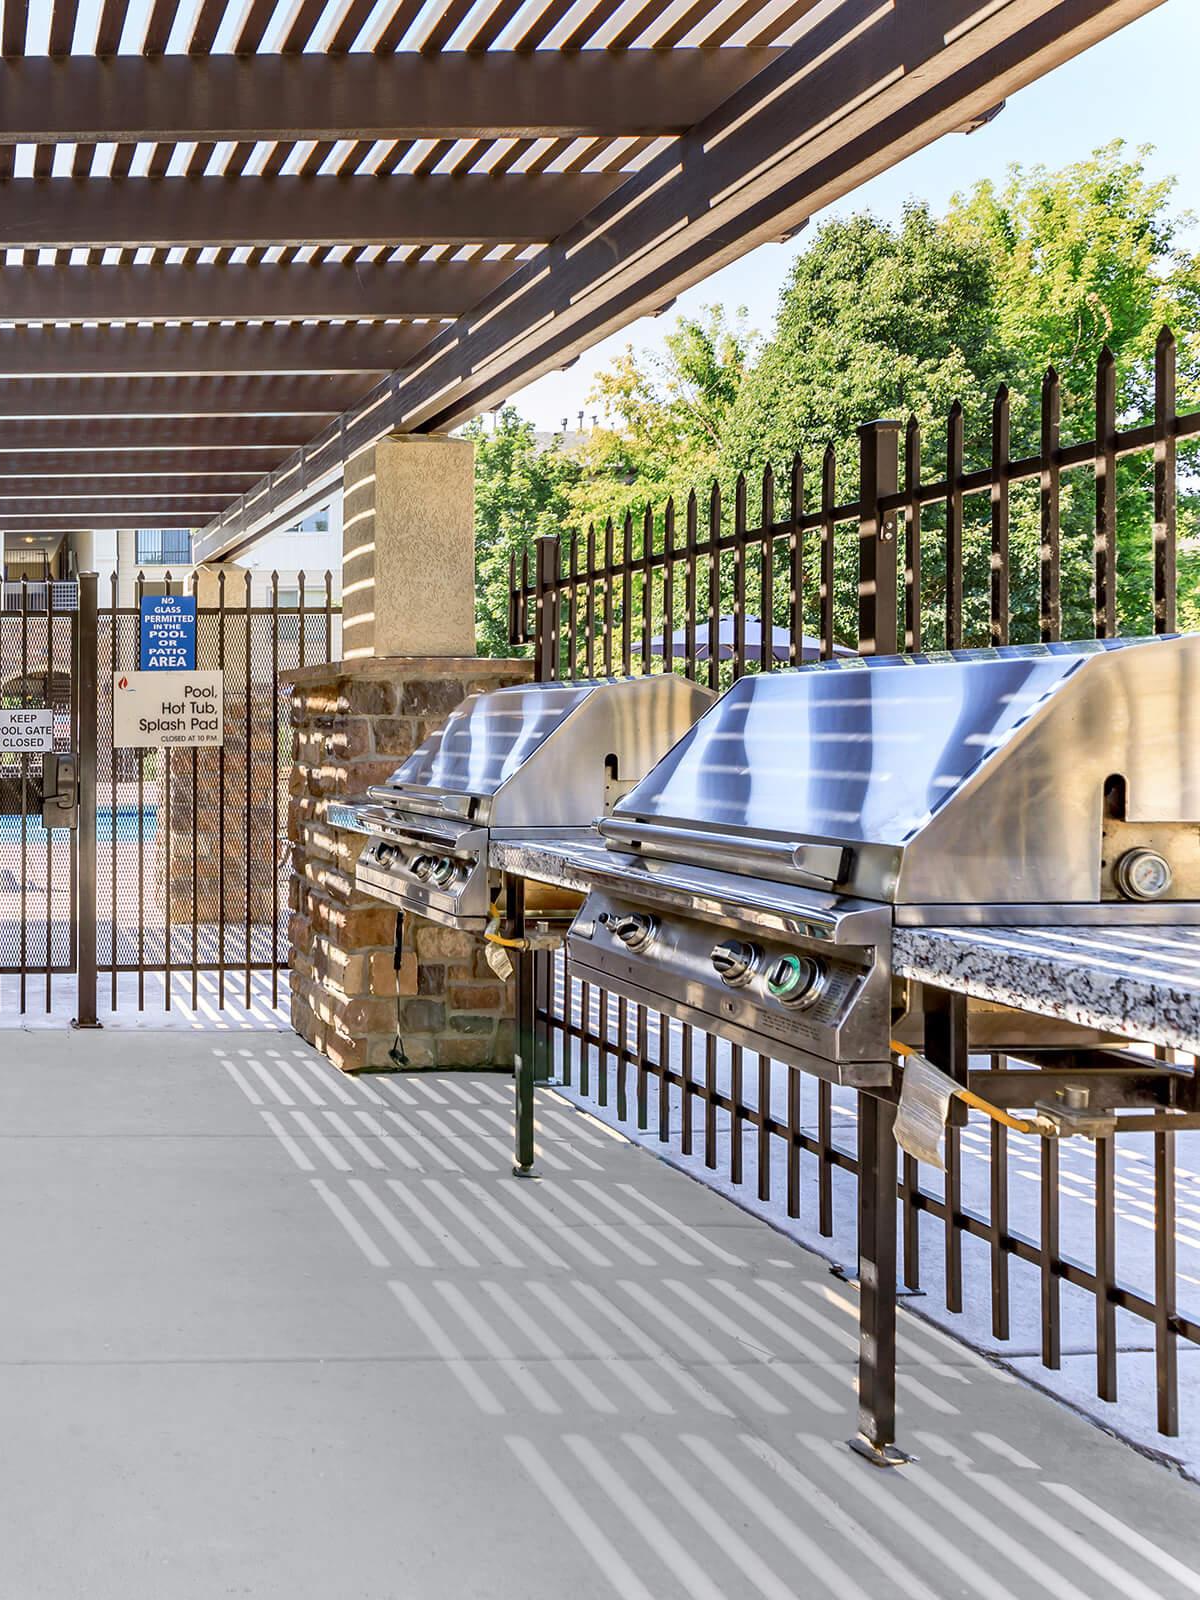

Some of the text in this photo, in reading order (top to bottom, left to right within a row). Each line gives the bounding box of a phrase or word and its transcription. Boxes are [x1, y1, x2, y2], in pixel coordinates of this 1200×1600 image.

[144, 615, 194, 623] PERMITTED
[148, 656, 187, 667] AREA
[184, 685, 218, 698] Pool,
[161, 701, 218, 714] Hot Tub,
[10, 714, 37, 723] KEEP
[25, 726, 52, 735] GATE
[139, 717, 218, 734] Splash Pad
[2, 738, 44, 747] CLOSED
